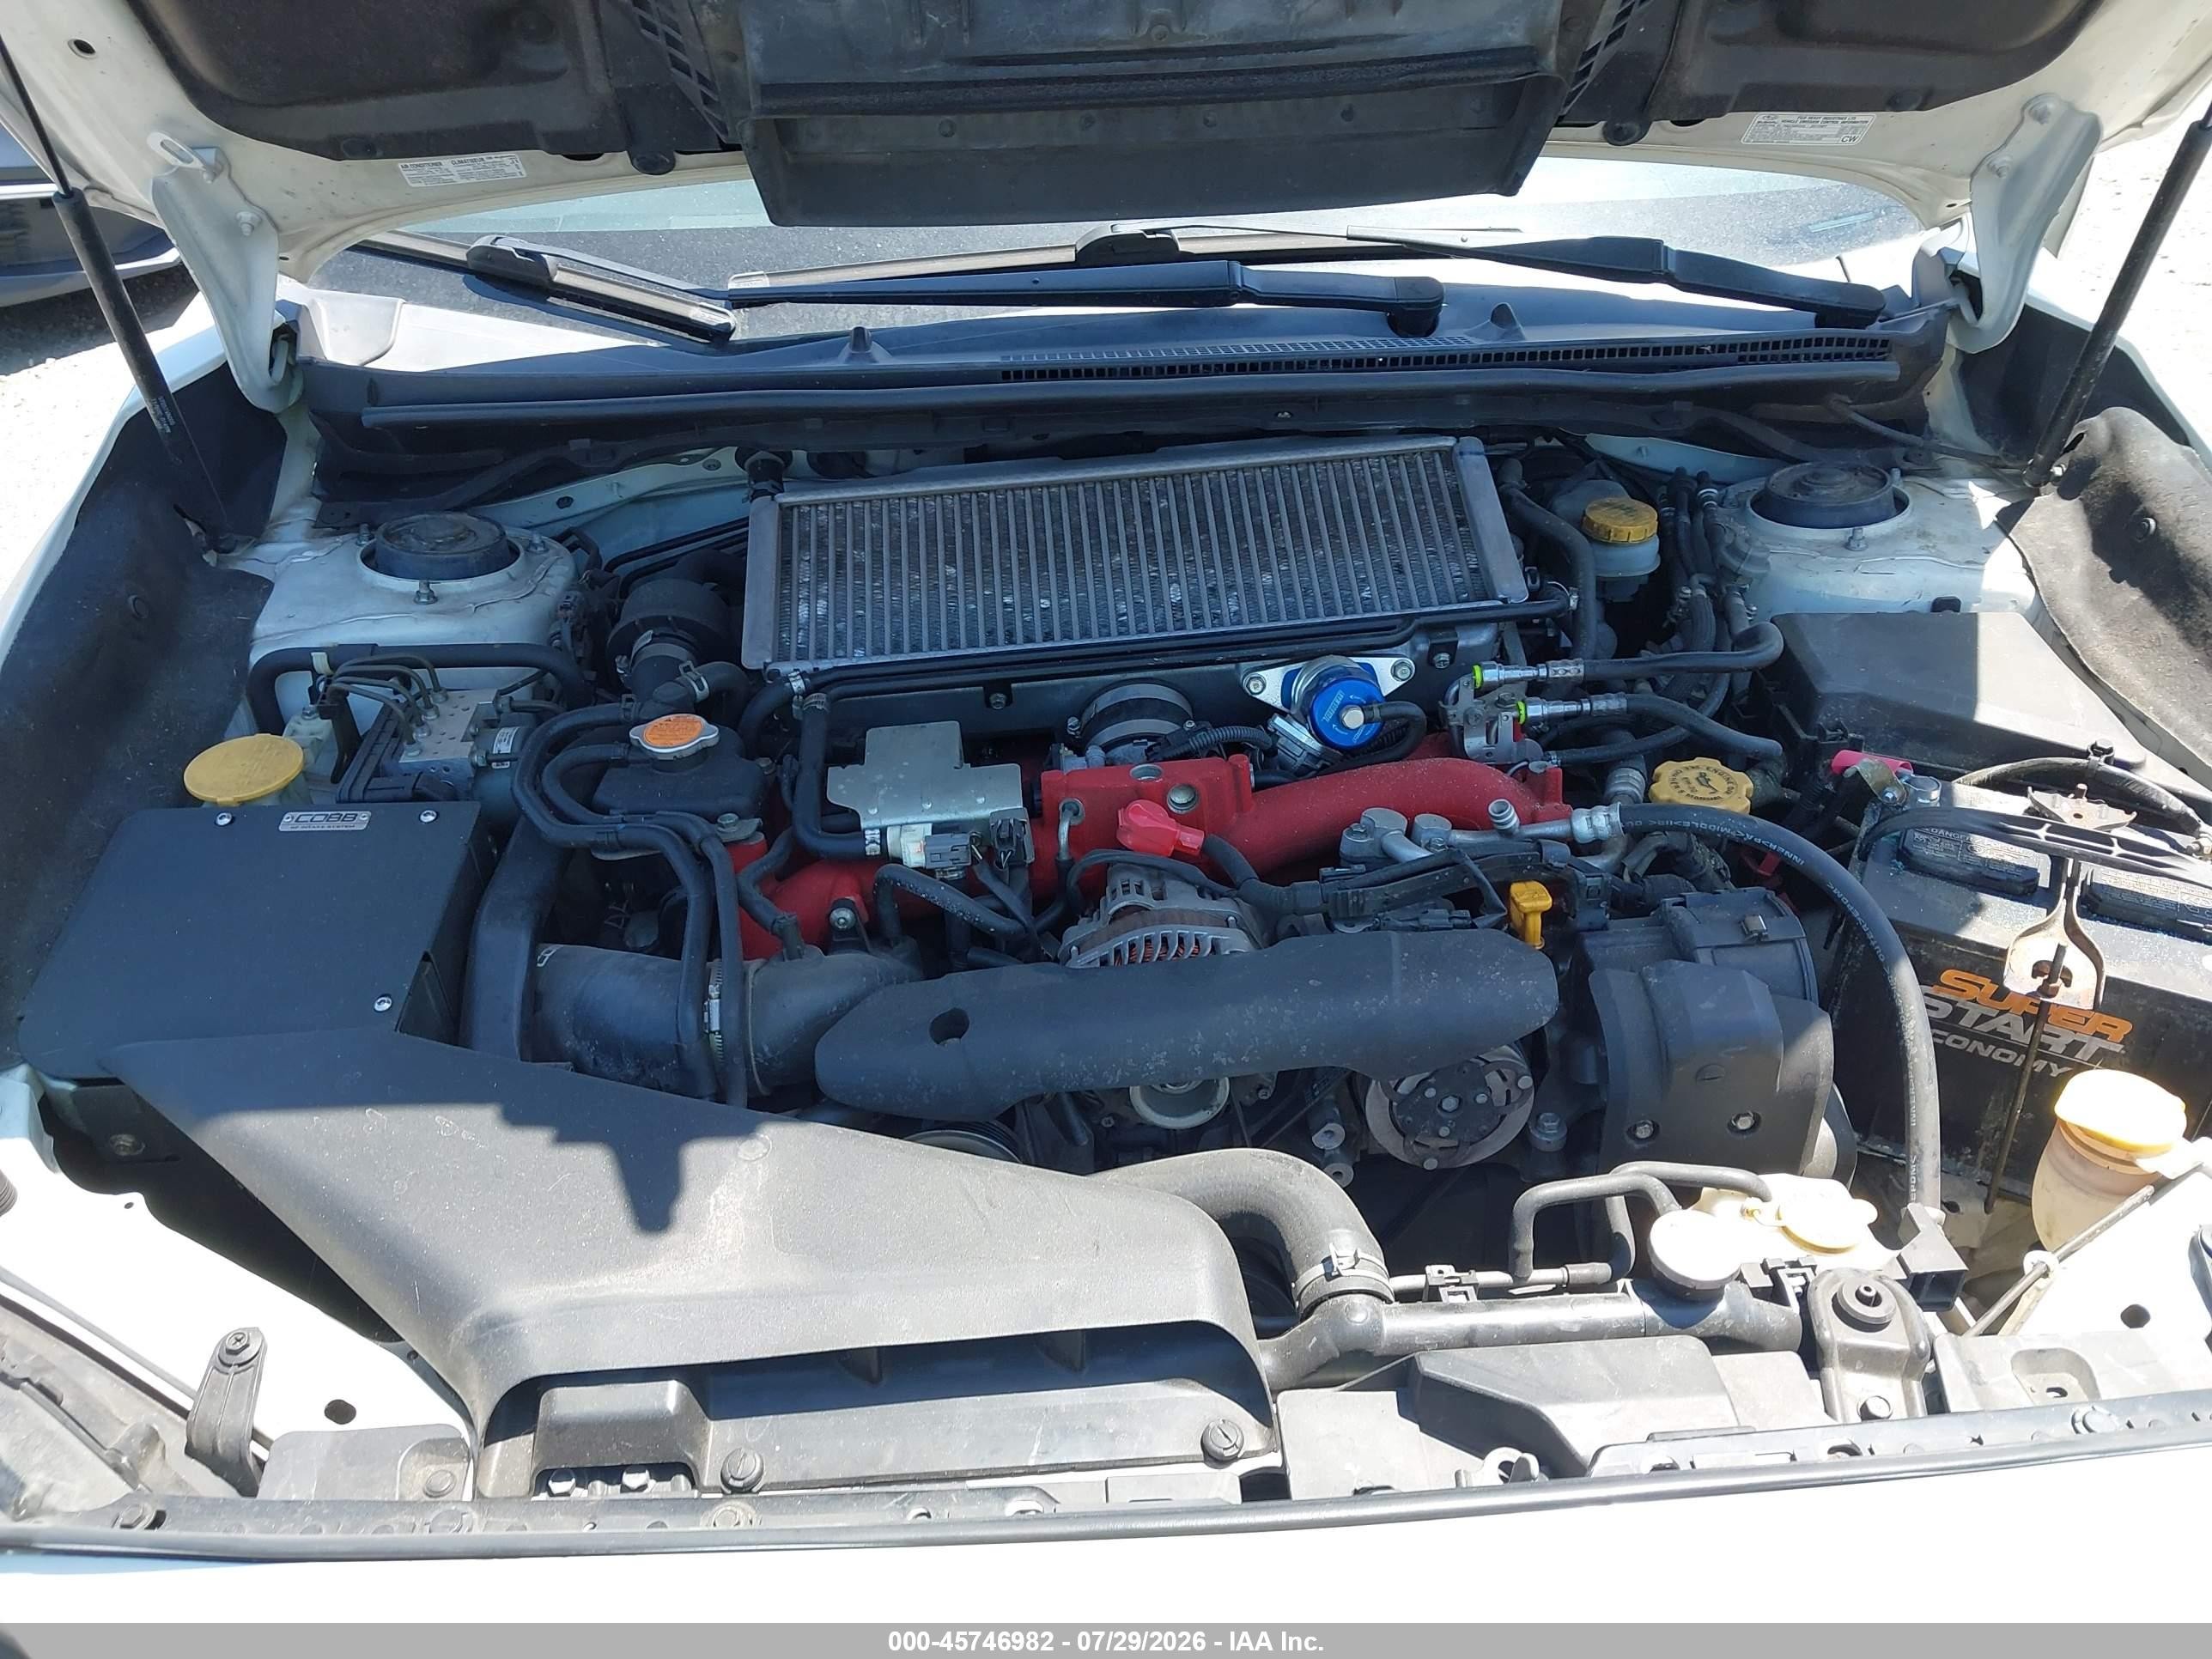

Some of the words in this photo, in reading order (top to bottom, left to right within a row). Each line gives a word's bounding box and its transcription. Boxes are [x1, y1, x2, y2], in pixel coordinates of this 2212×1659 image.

[295, 813, 358, 823] COBB
[1929, 828, 1972, 842] DANGER
[1921, 985, 2125, 1061] START
[1933, 969, 2132, 1042] SUPER
[1931, 1029, 2073, 1077] CONOMY
